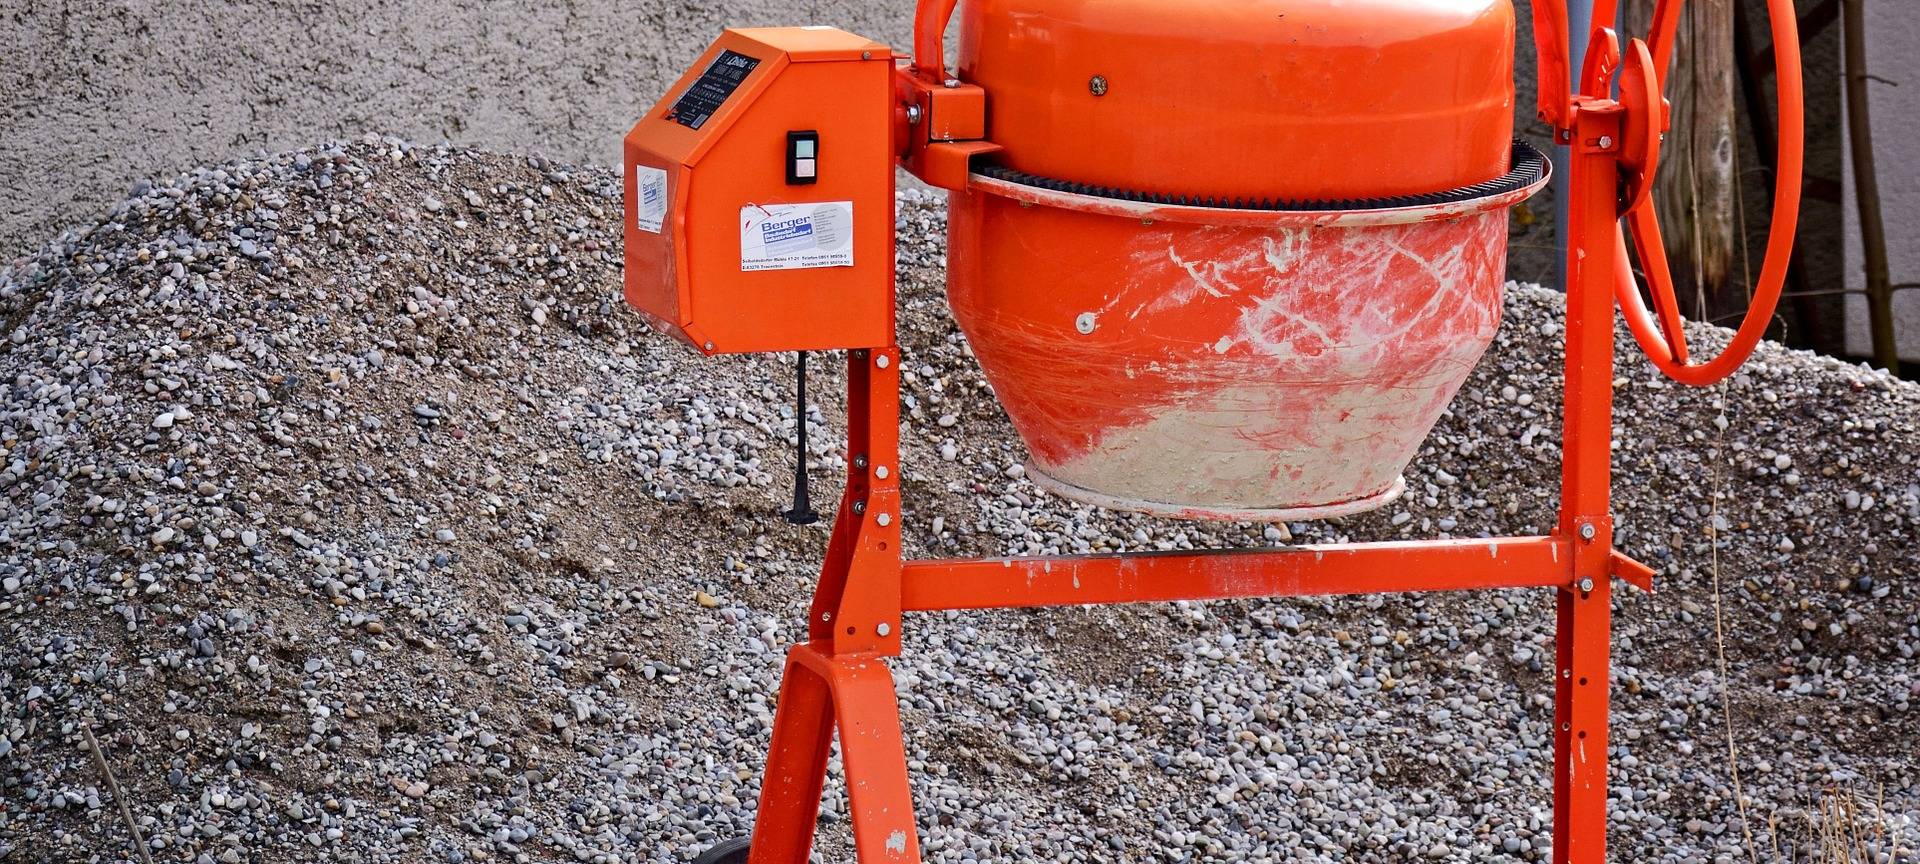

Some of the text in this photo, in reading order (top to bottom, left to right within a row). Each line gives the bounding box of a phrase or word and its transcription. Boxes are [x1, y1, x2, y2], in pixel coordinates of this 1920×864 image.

[761, 216, 810, 232] Berger
[765, 227, 796, 238] Baubedarf
[766, 229, 811, 242] Industriebedarf
